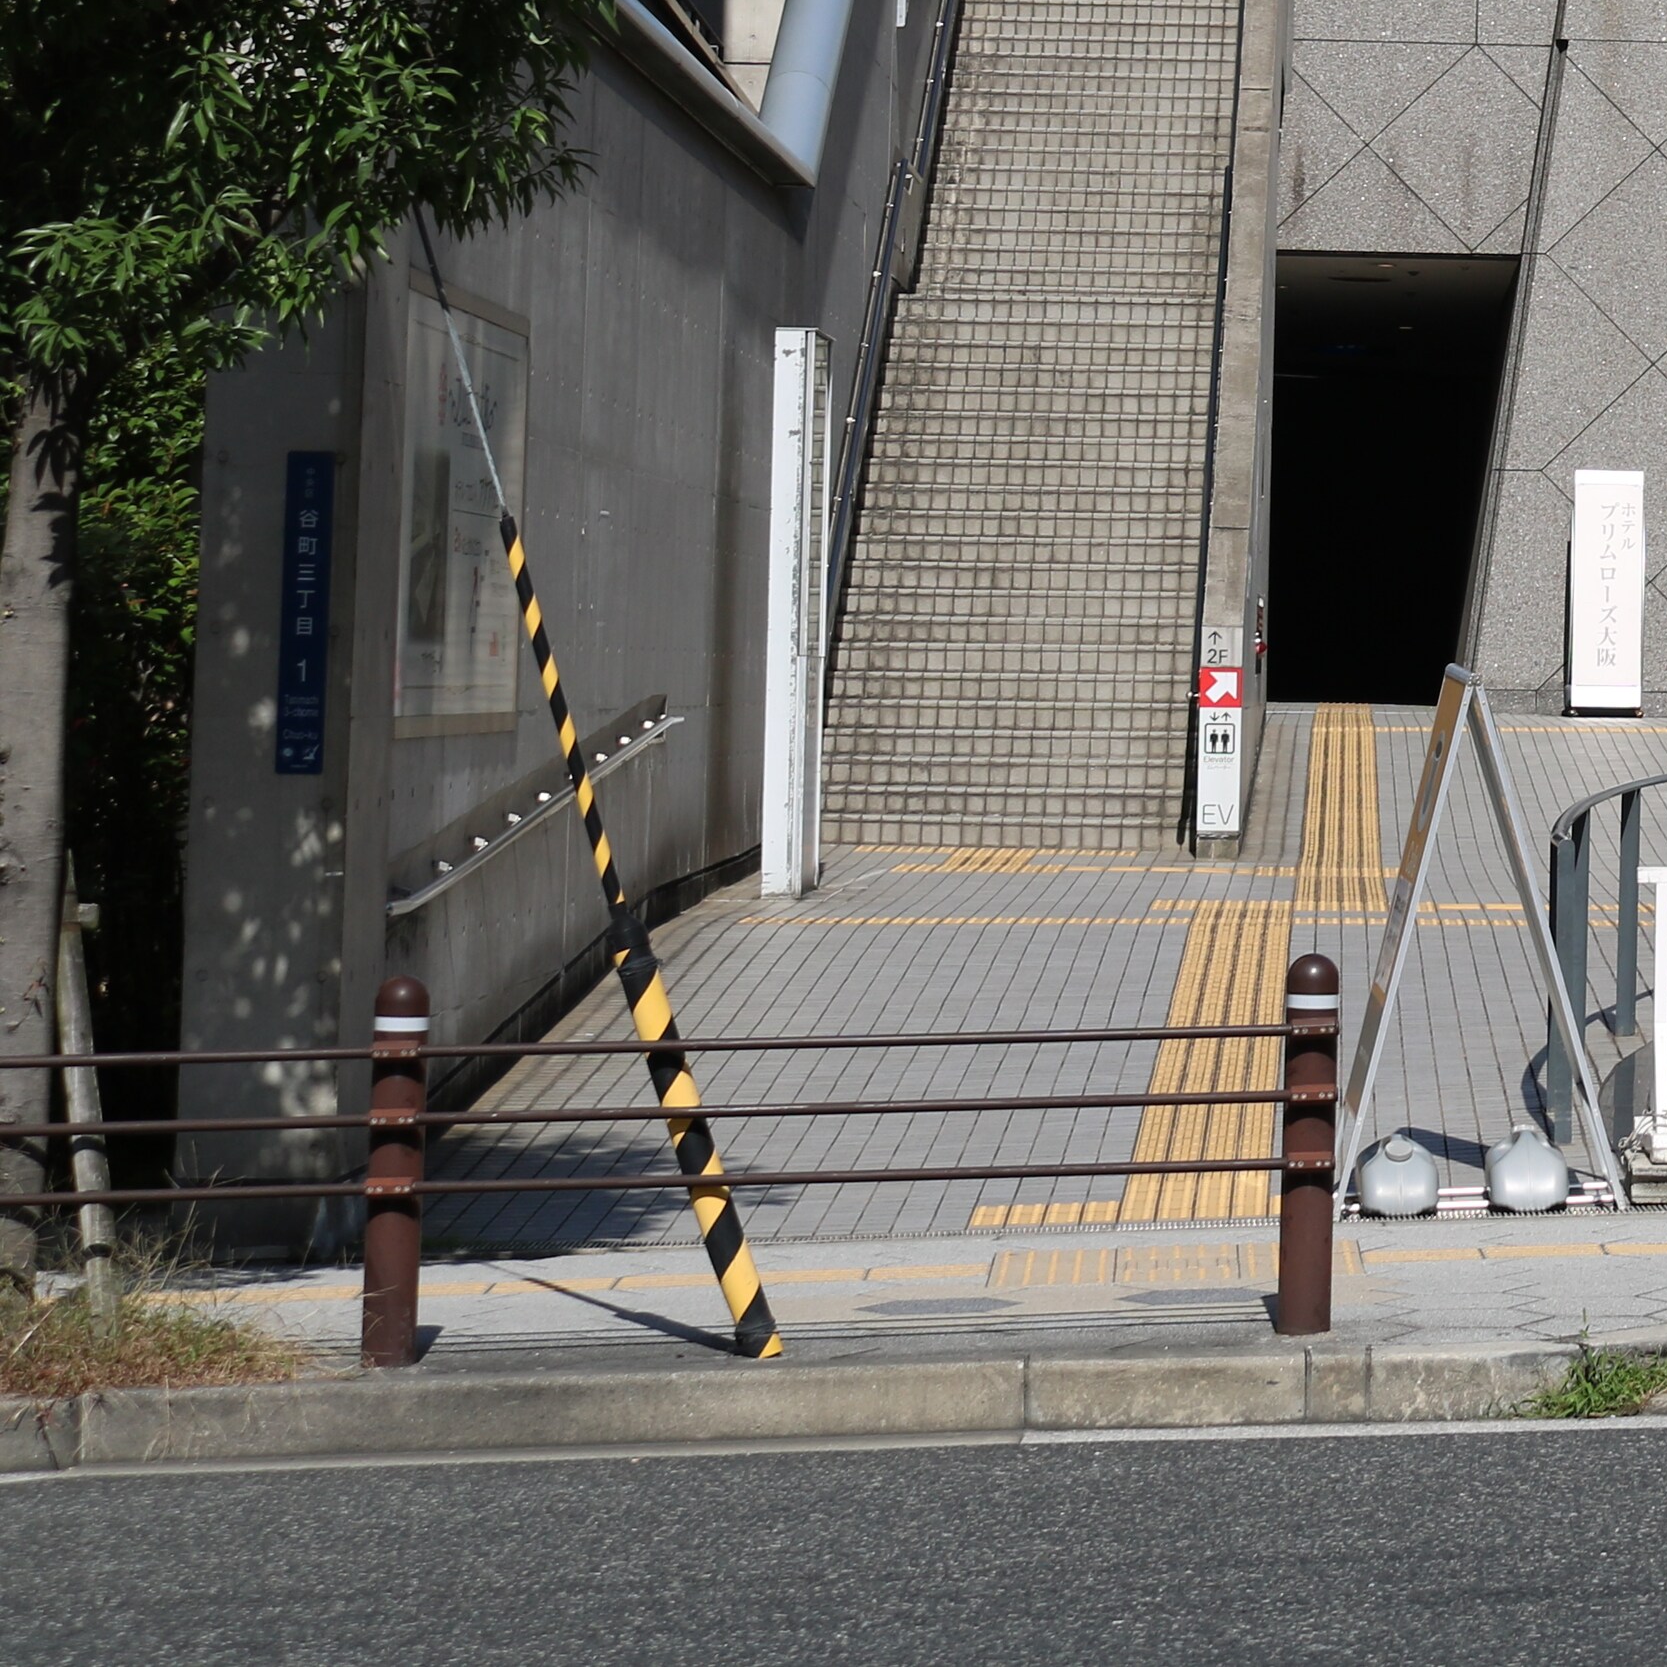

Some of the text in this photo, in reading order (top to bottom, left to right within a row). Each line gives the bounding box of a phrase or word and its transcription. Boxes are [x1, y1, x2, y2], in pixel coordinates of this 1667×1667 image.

[1620, 501, 1637, 551] ホテル
[296, 509, 319, 682] 谷町三丁目 1
[1596, 500, 1621, 668] プリムローズ大阪
[1206, 648, 1229, 664] 2F
[1203, 755, 1235, 764] Elevator
[1202, 803, 1235, 826] EV
